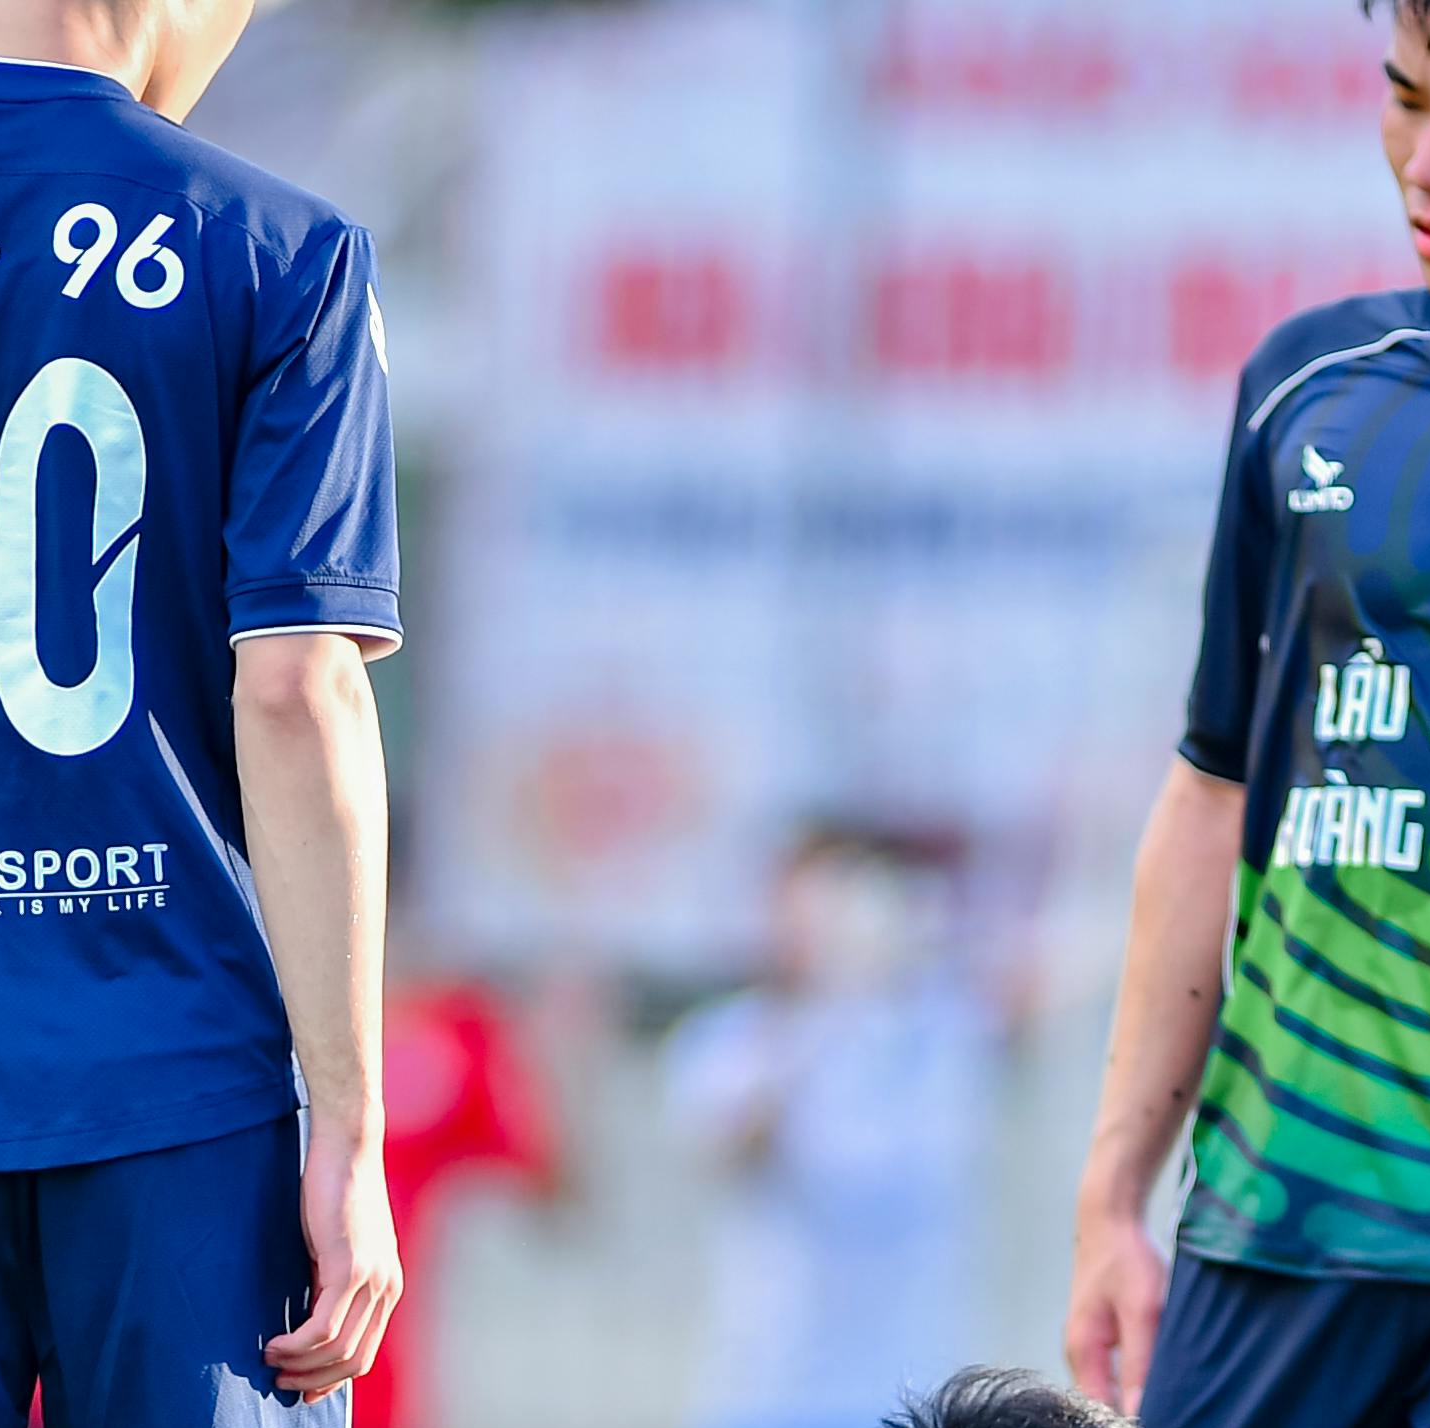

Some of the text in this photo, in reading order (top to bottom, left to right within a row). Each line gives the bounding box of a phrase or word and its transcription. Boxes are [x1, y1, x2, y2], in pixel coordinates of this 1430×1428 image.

[53, 202, 185, 309] 96
[19, 897, 44, 915] IS
[59, 896, 91, 914] MY
[107, 891, 167, 912] LIFE
